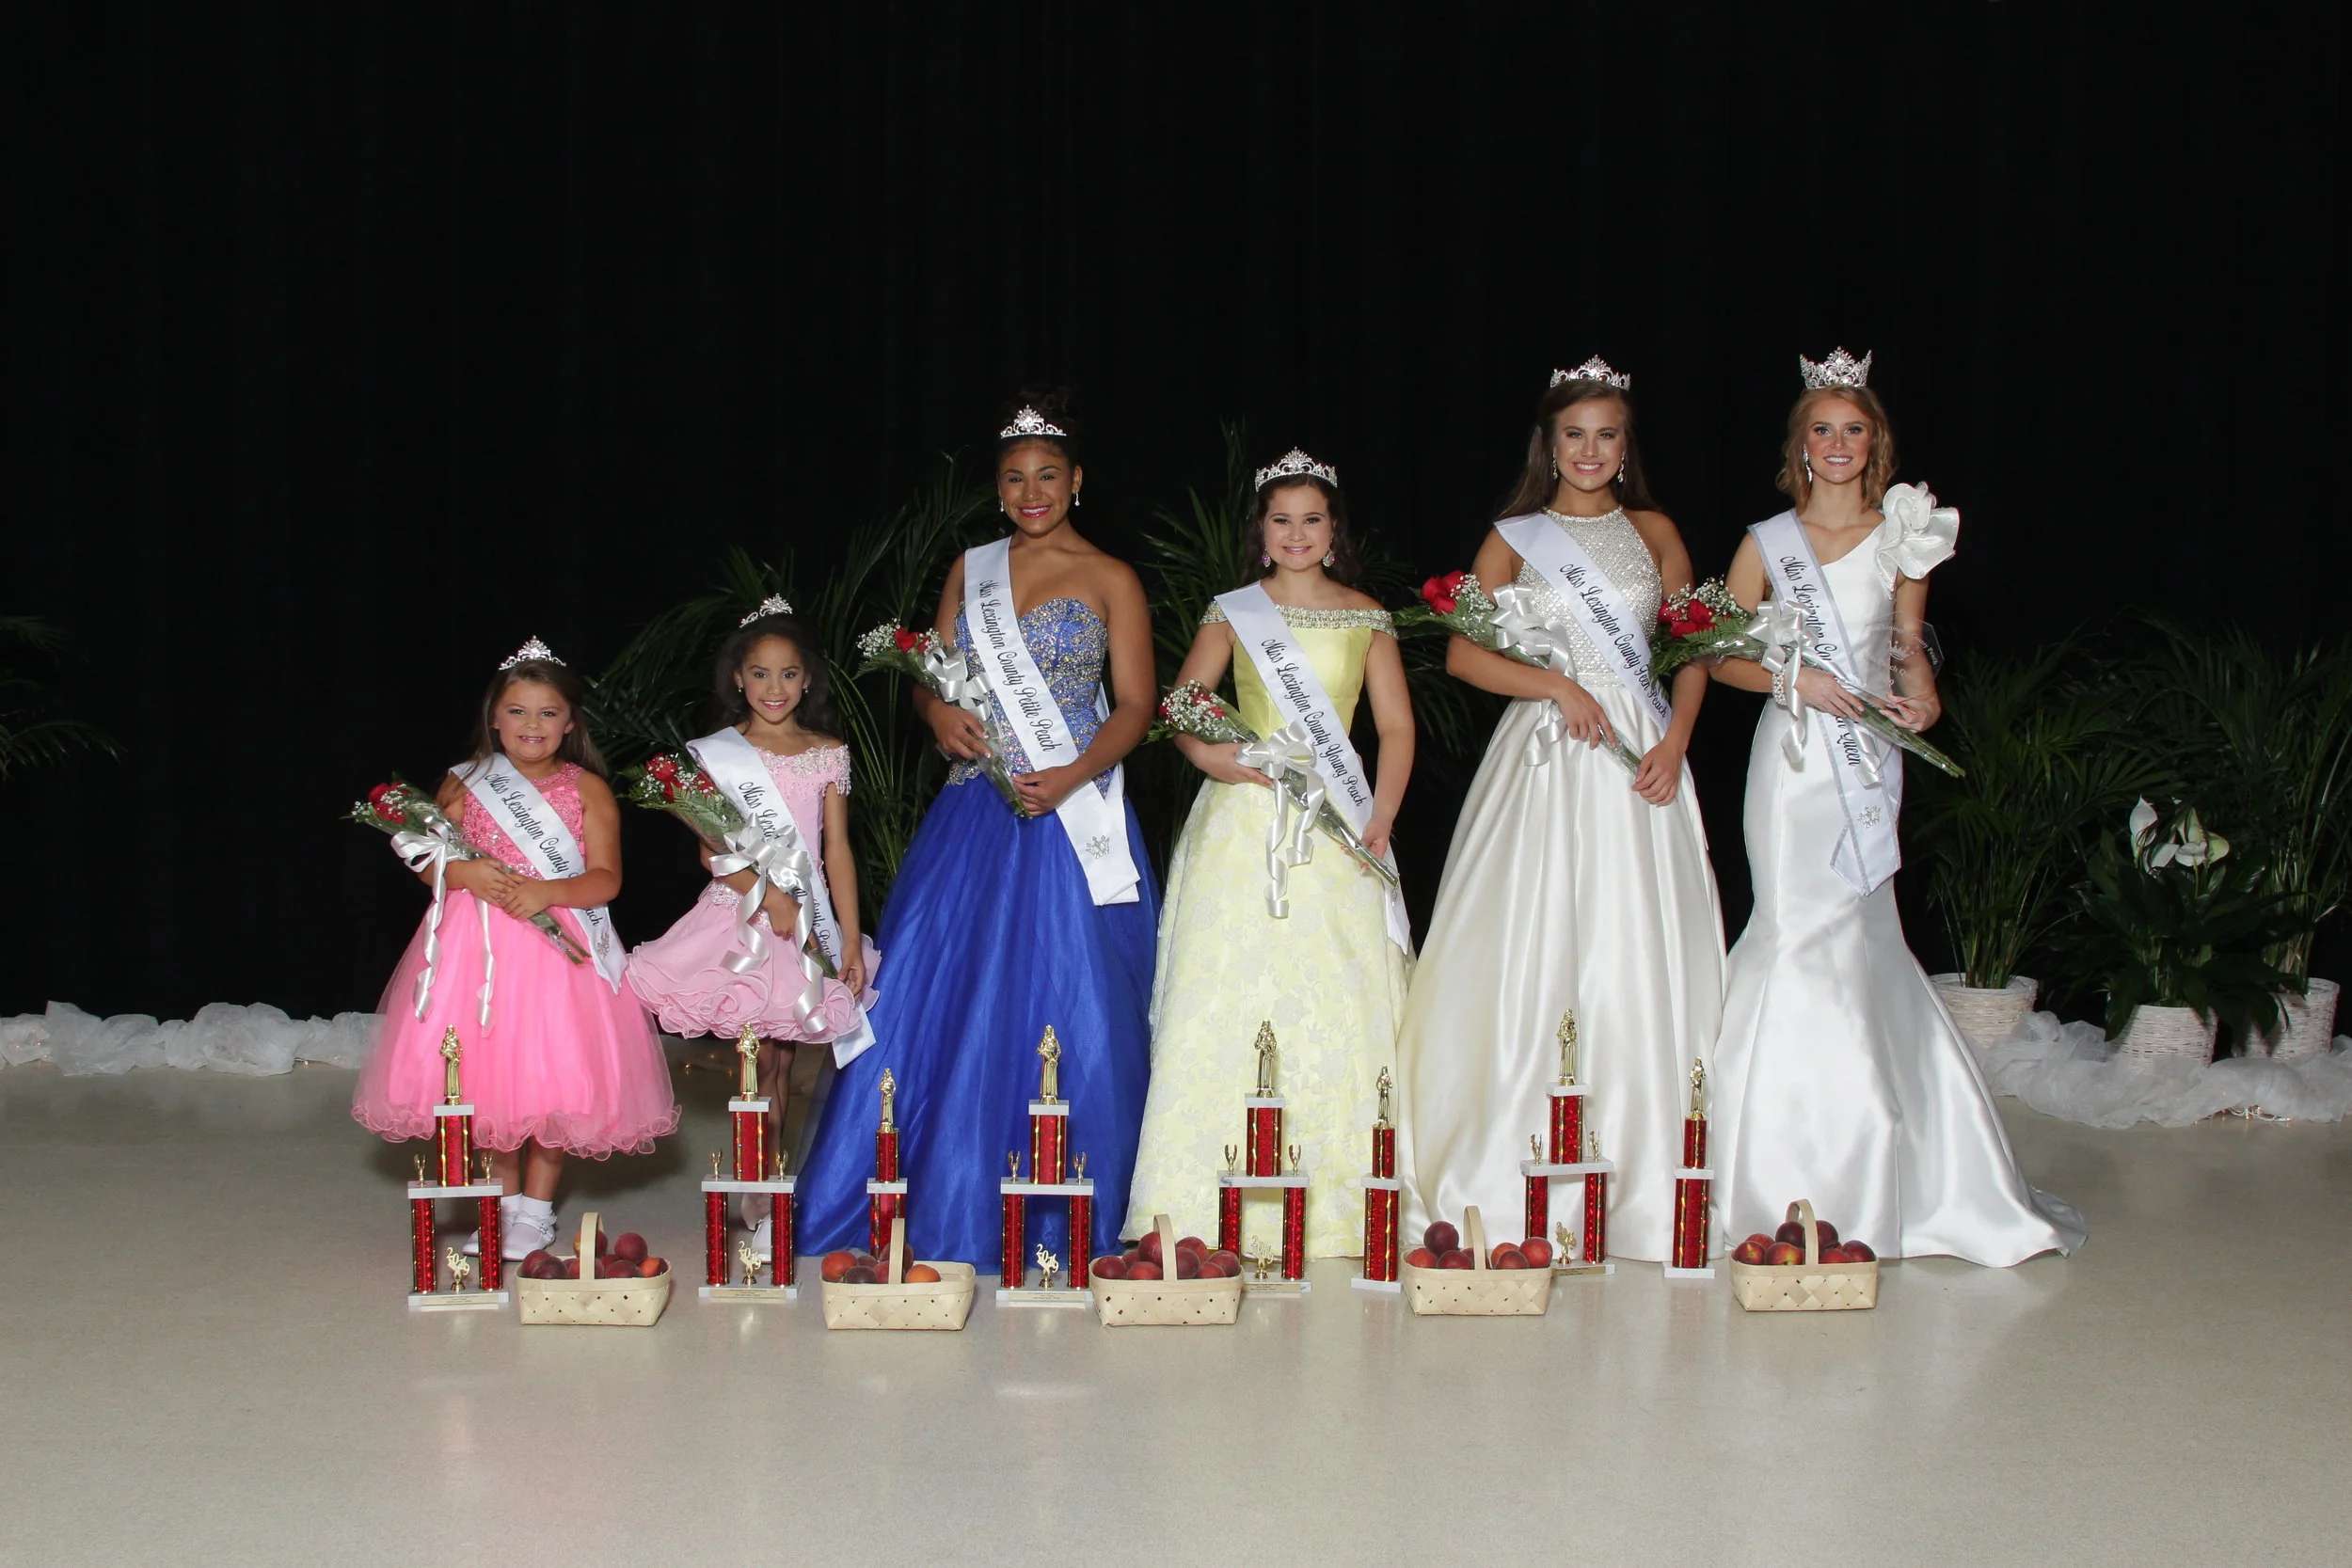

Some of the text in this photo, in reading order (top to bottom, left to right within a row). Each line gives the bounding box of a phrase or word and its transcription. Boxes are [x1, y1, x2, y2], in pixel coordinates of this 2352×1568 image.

[1560, 563, 1588, 589] Miss
[1580, 586, 1620, 636] Lexington
[1614, 633, 1644, 670] County
[1780, 556, 1806, 581] Miss
[979, 579, 1062, 752] Miss Lexington County Petite Peach
[1261, 639, 1367, 807] Miss Lexington County Young Peach
[485, 773, 570, 873] Miss Lexington County
[739, 782, 765, 809] Miss
[582, 908, 604, 927] ach
